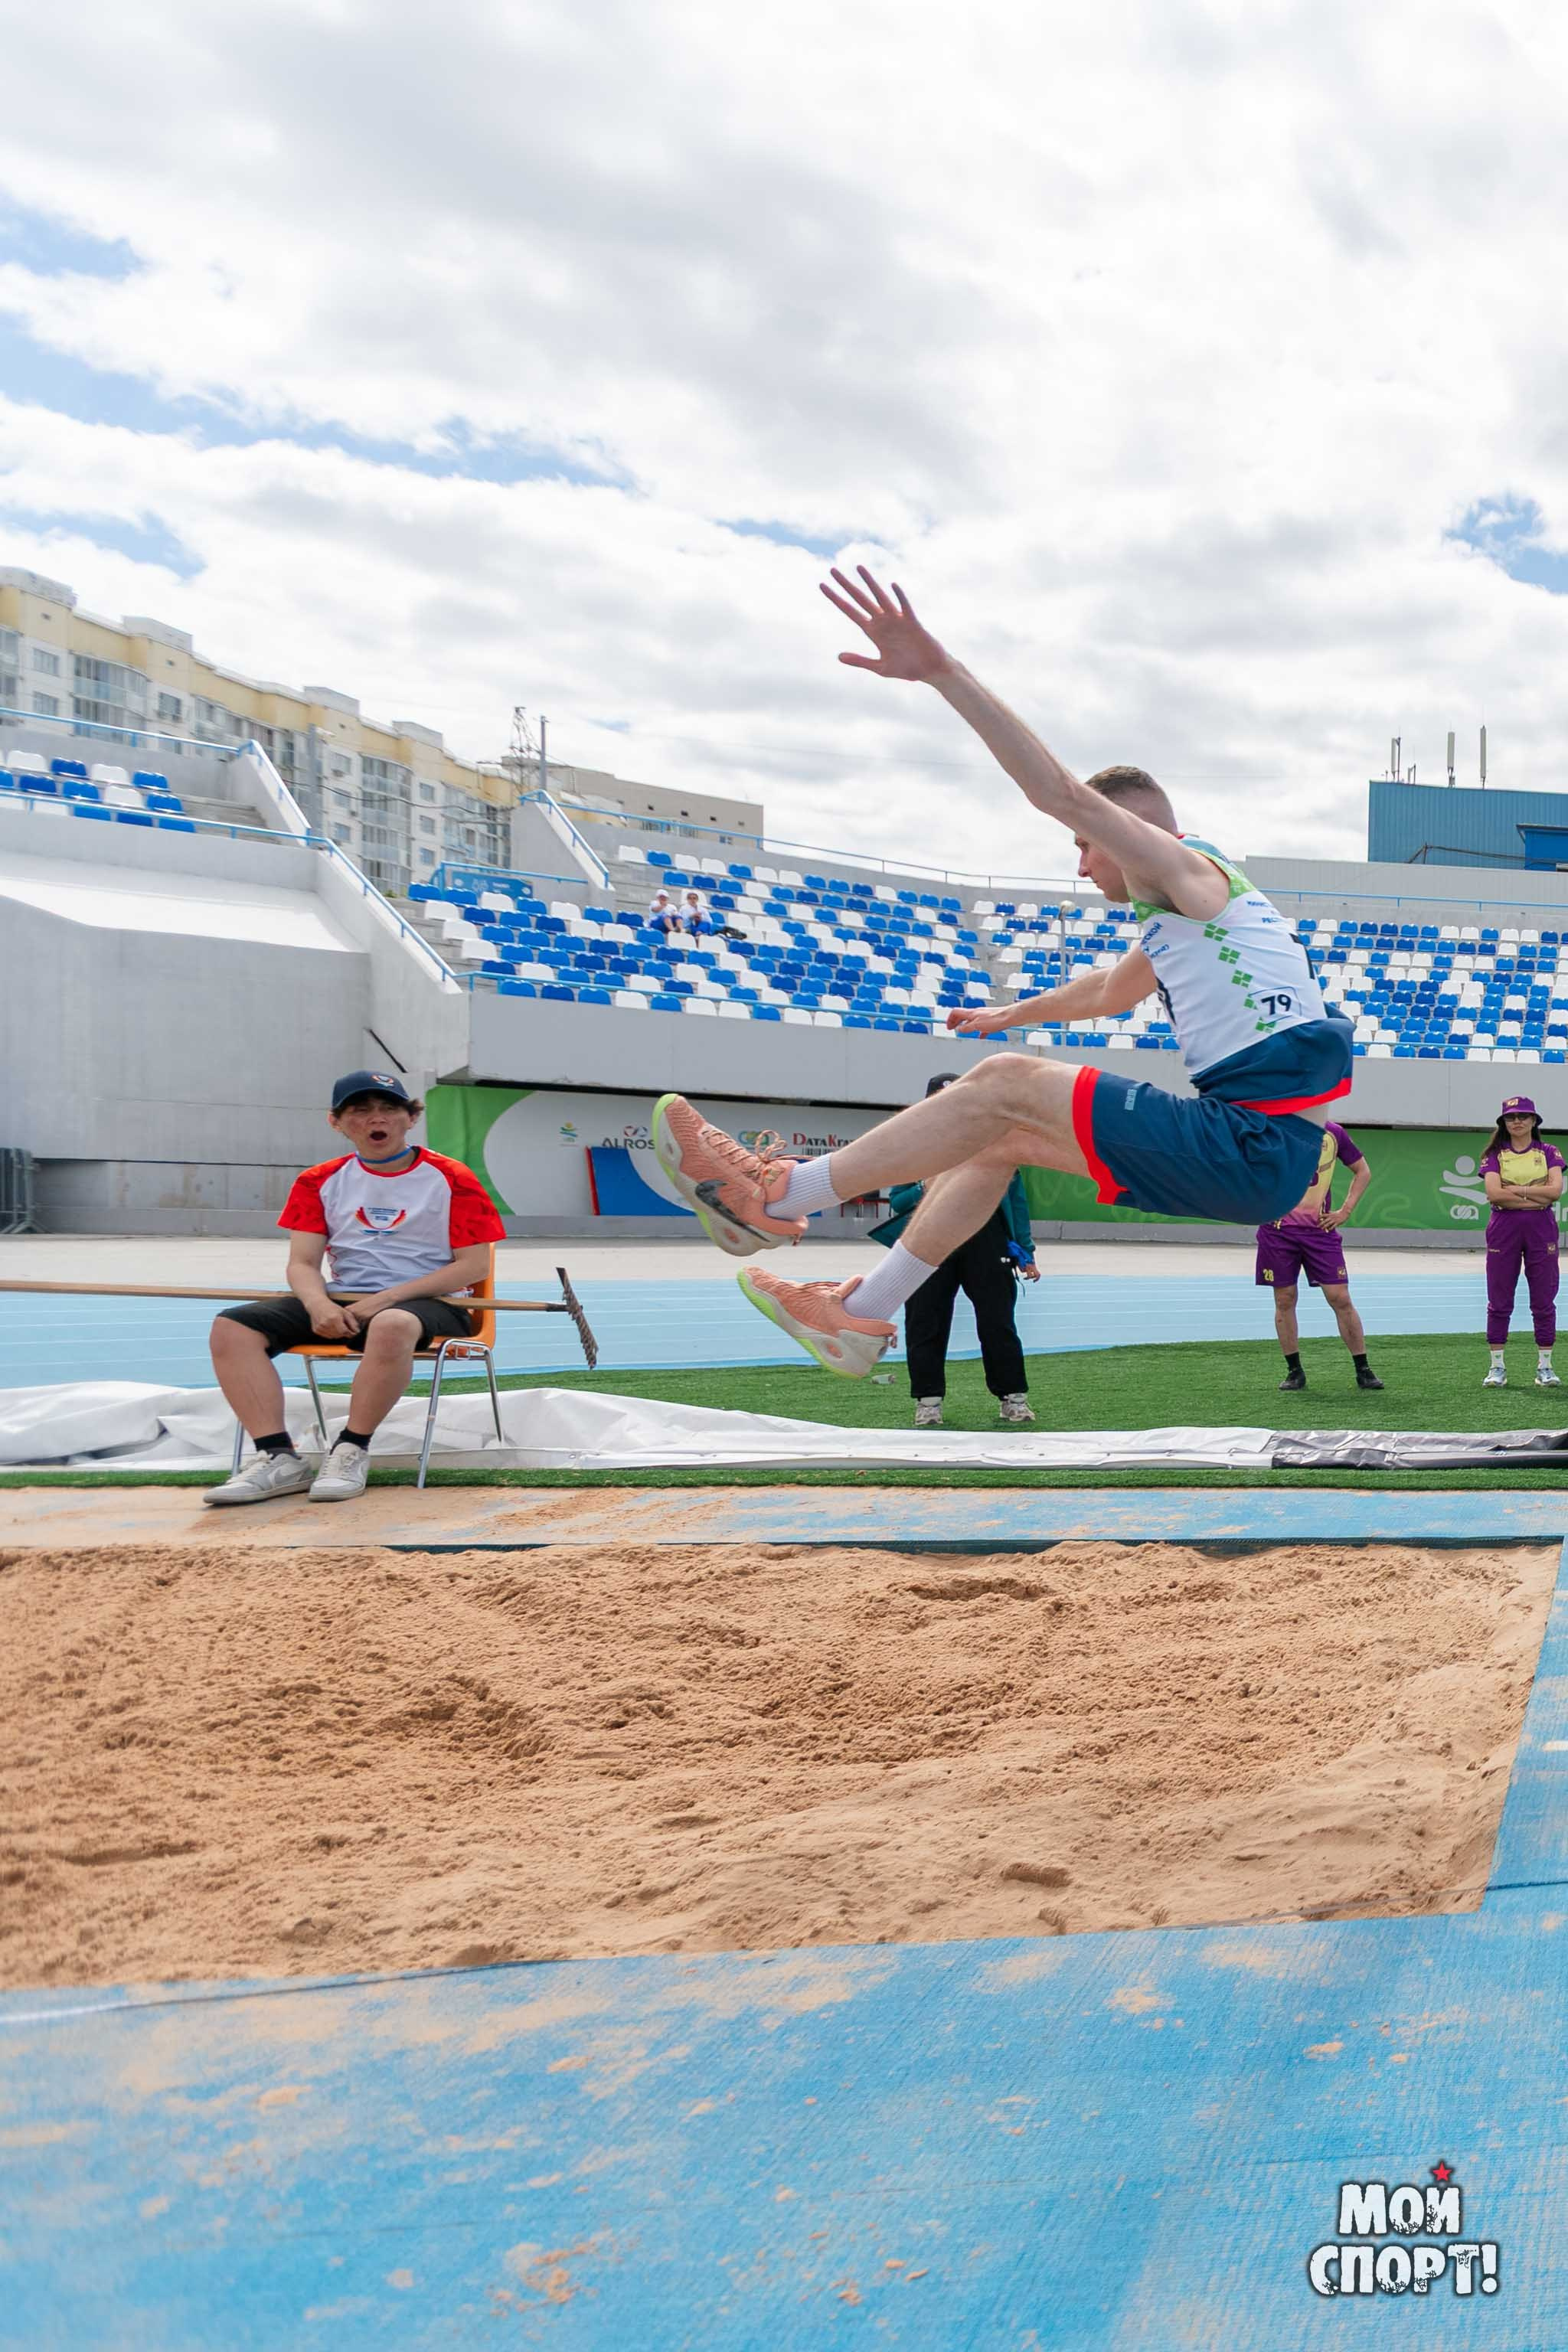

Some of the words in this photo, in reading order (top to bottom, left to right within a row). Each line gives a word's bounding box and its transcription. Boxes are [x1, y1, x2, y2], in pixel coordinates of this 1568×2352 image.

[1260, 993, 1292, 1016] 79
[601, 1137, 656, 1150] ALROS
[1263, 1268, 1275, 1282] 28
